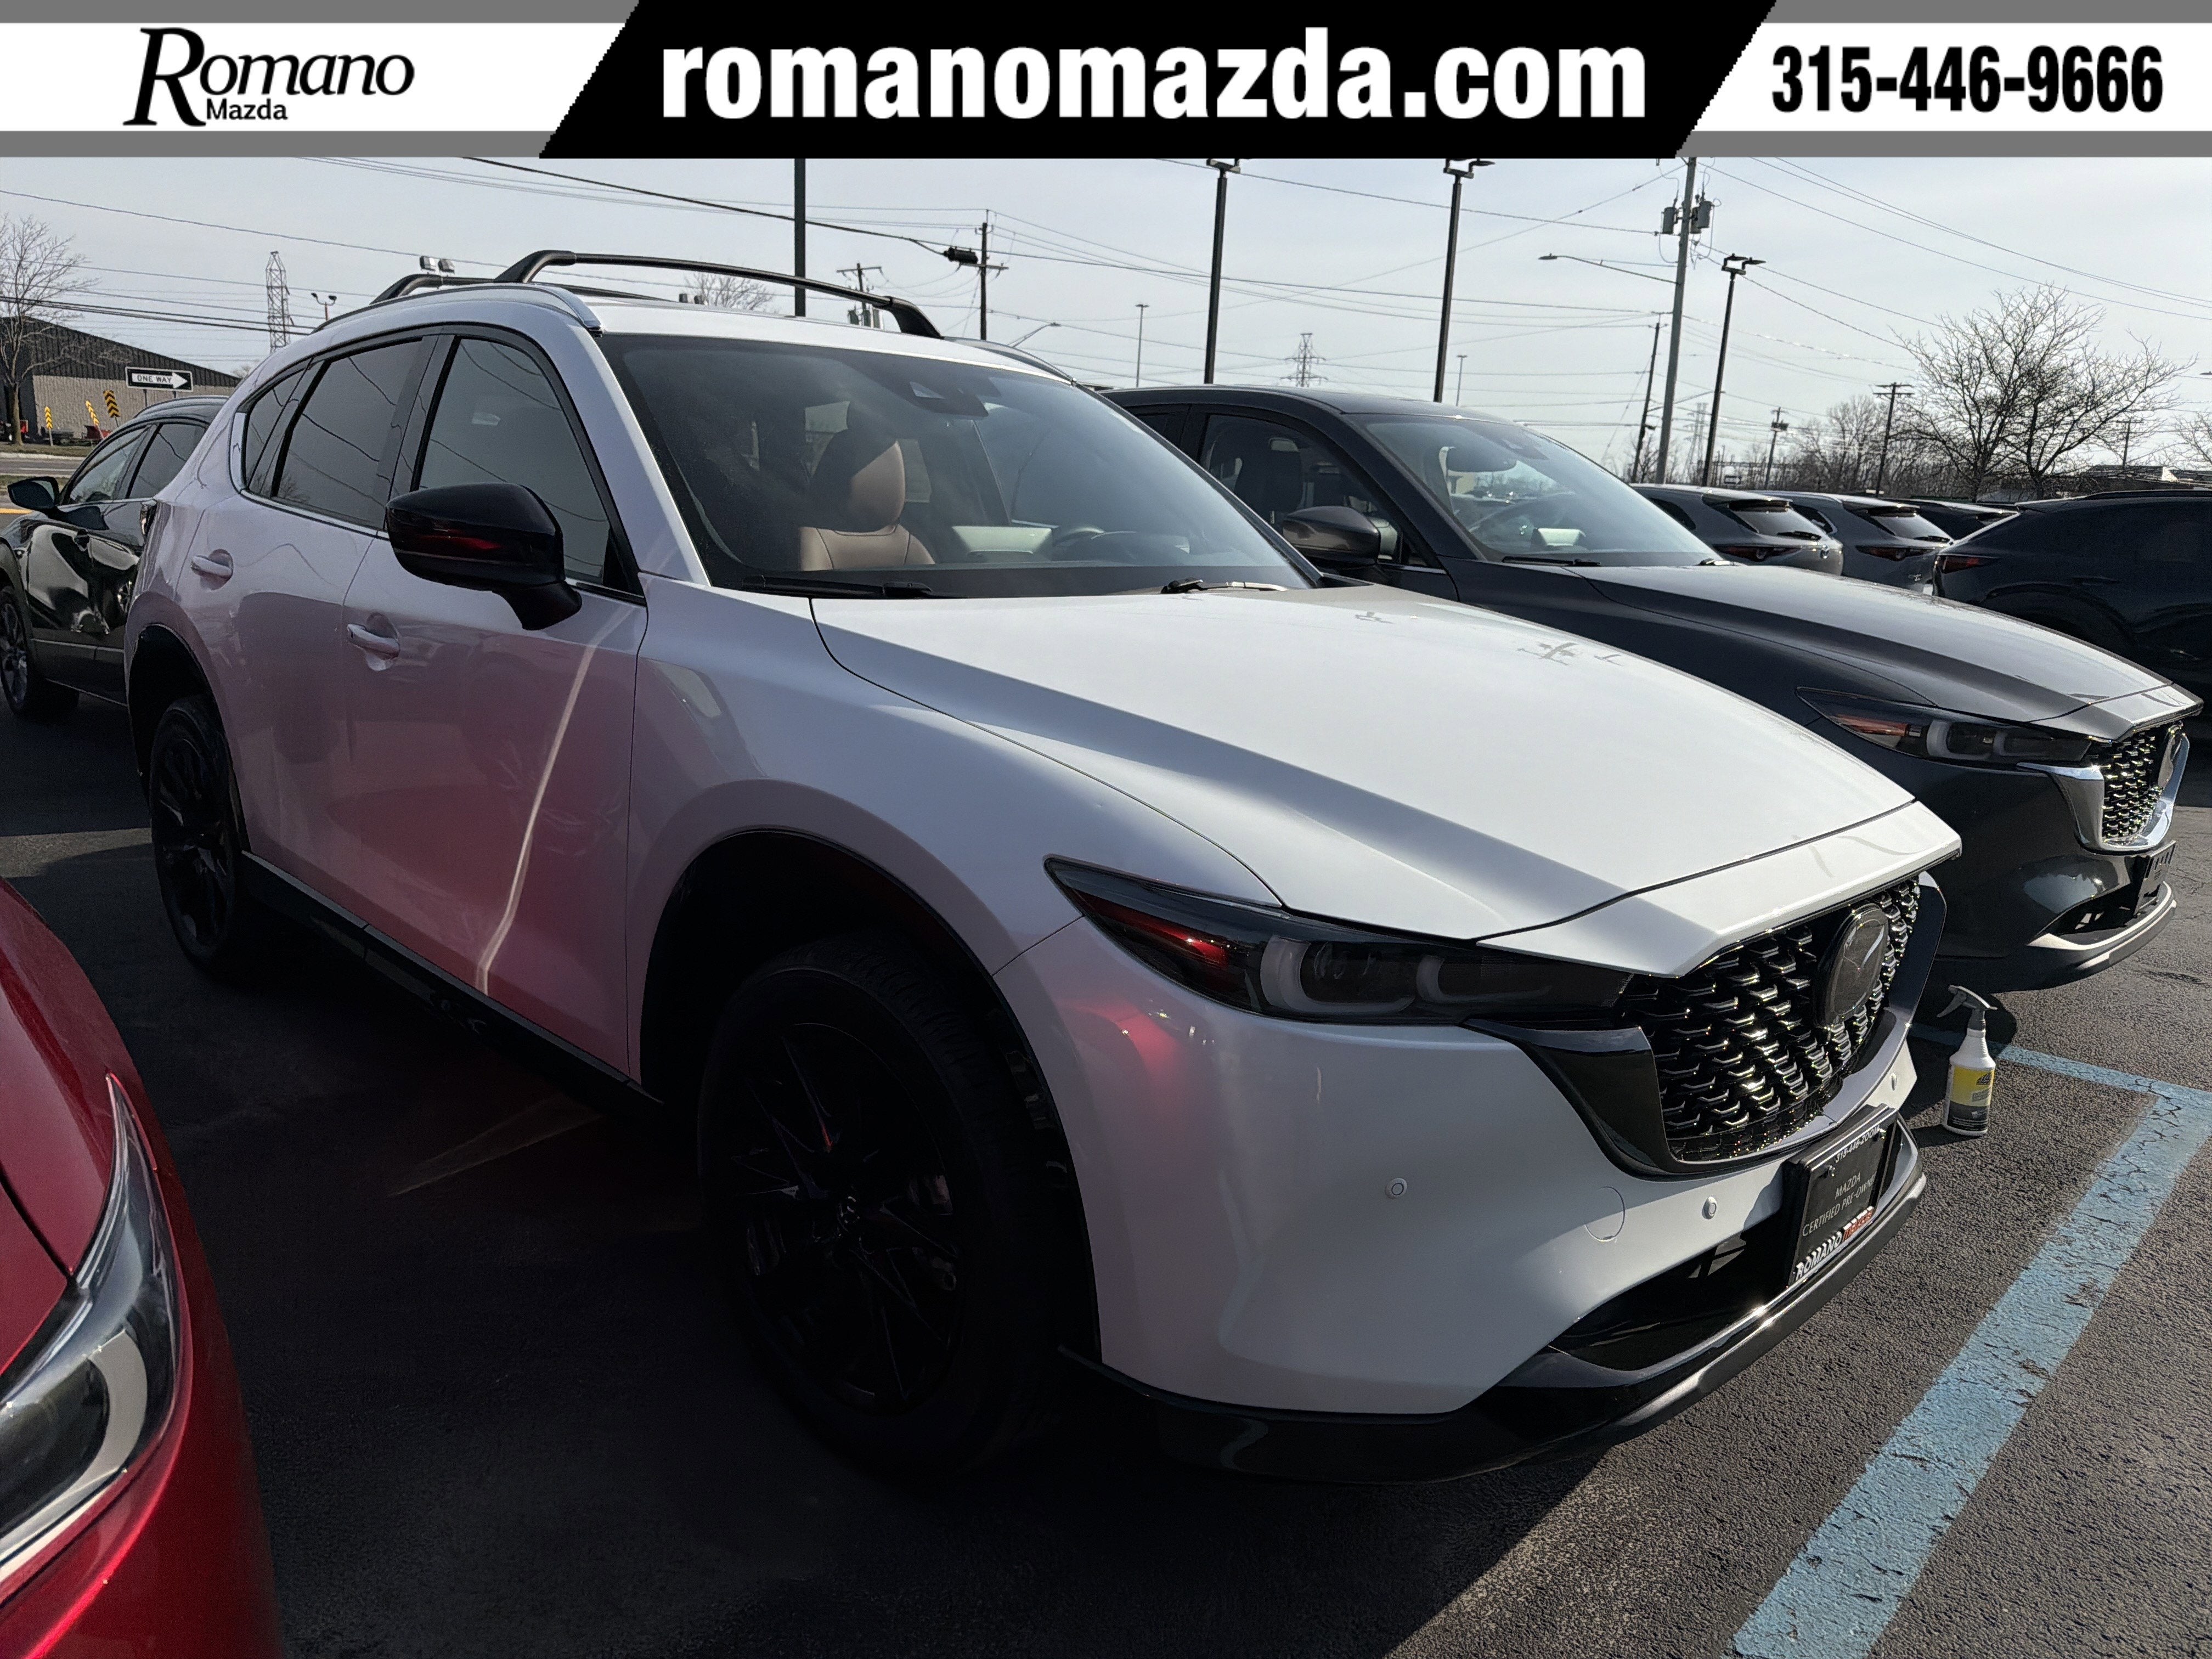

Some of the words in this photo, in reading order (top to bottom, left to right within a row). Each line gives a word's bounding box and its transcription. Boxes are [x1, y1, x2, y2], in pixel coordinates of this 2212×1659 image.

[1835, 1172, 1860, 1200] MAZDA
[1802, 1203, 1841, 1236] CERTIFIED
[1796, 1231, 1842, 1281] ROMANO
